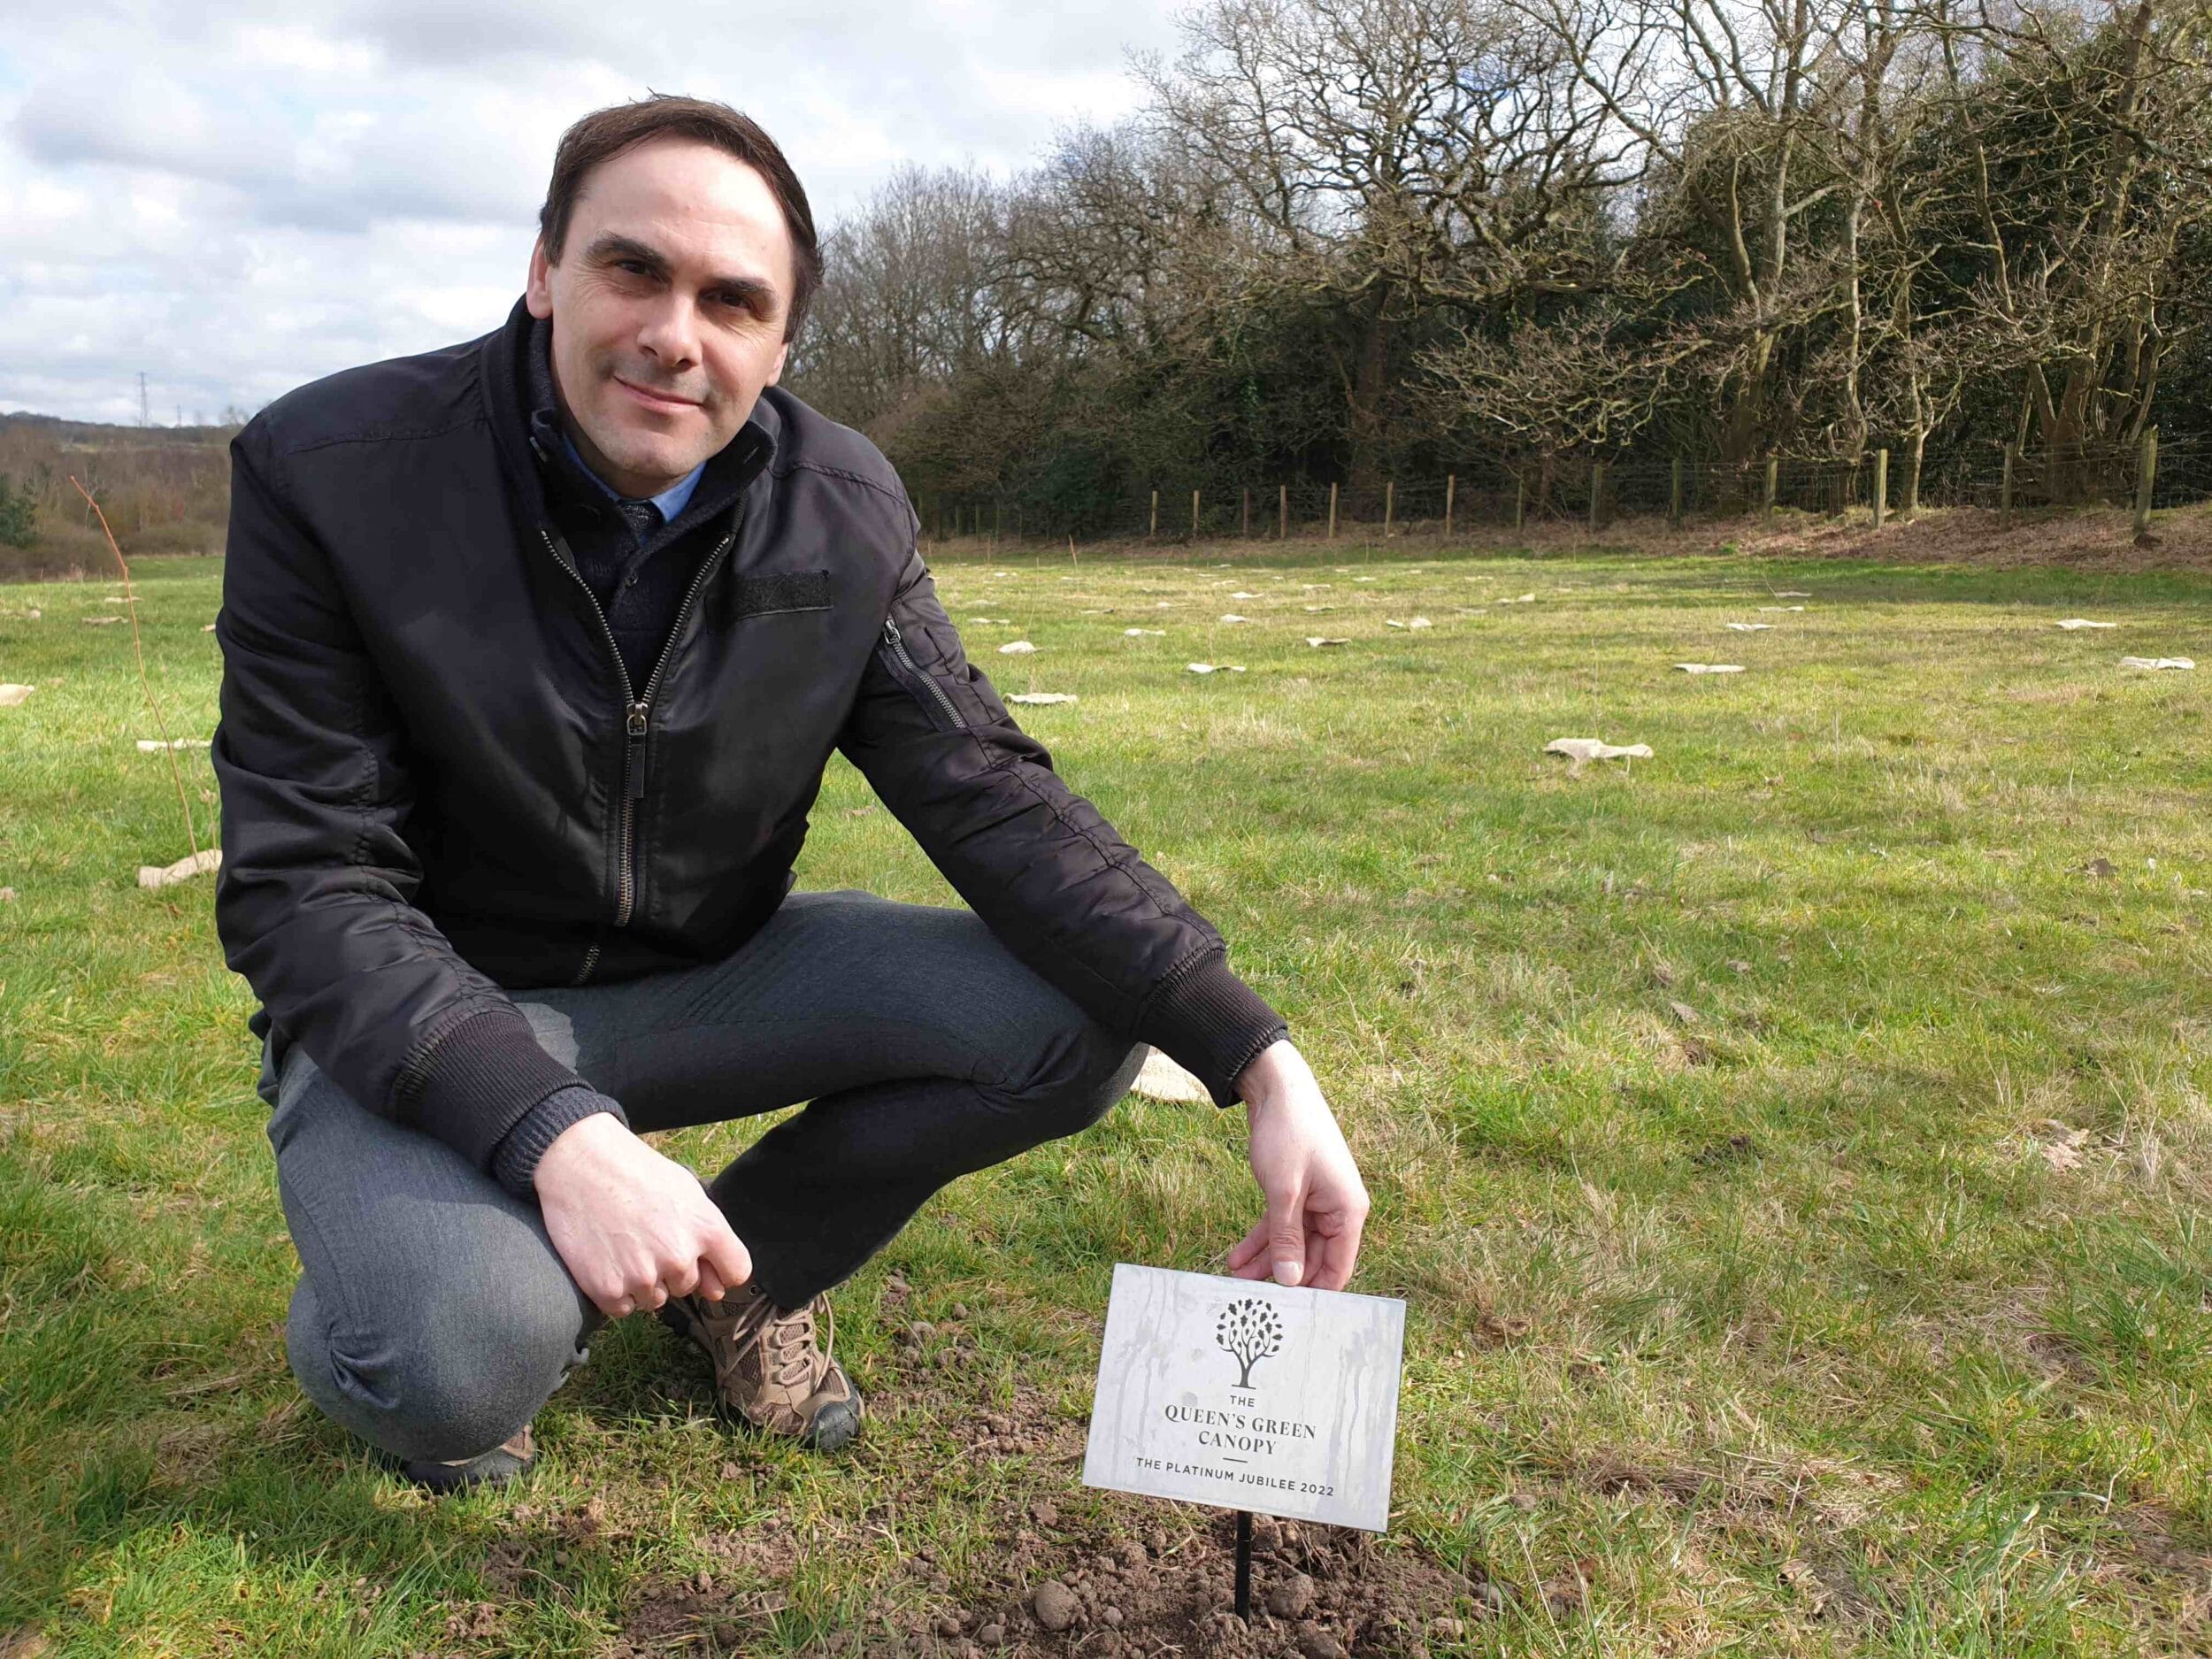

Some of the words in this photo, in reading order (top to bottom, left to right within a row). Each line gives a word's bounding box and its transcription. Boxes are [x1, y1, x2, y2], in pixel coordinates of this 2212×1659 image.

[1230, 1394, 1255, 1408] THE
[1251, 1417, 1317, 1440] GREEN
[1198, 1431, 1278, 1455] CANOPY
[1136, 1457, 1161, 1471] THE
[1166, 1462, 1234, 1481] PLATINUM
[1239, 1472, 1295, 1491] JUBILEE
[1301, 1483, 1334, 1496] 2022
